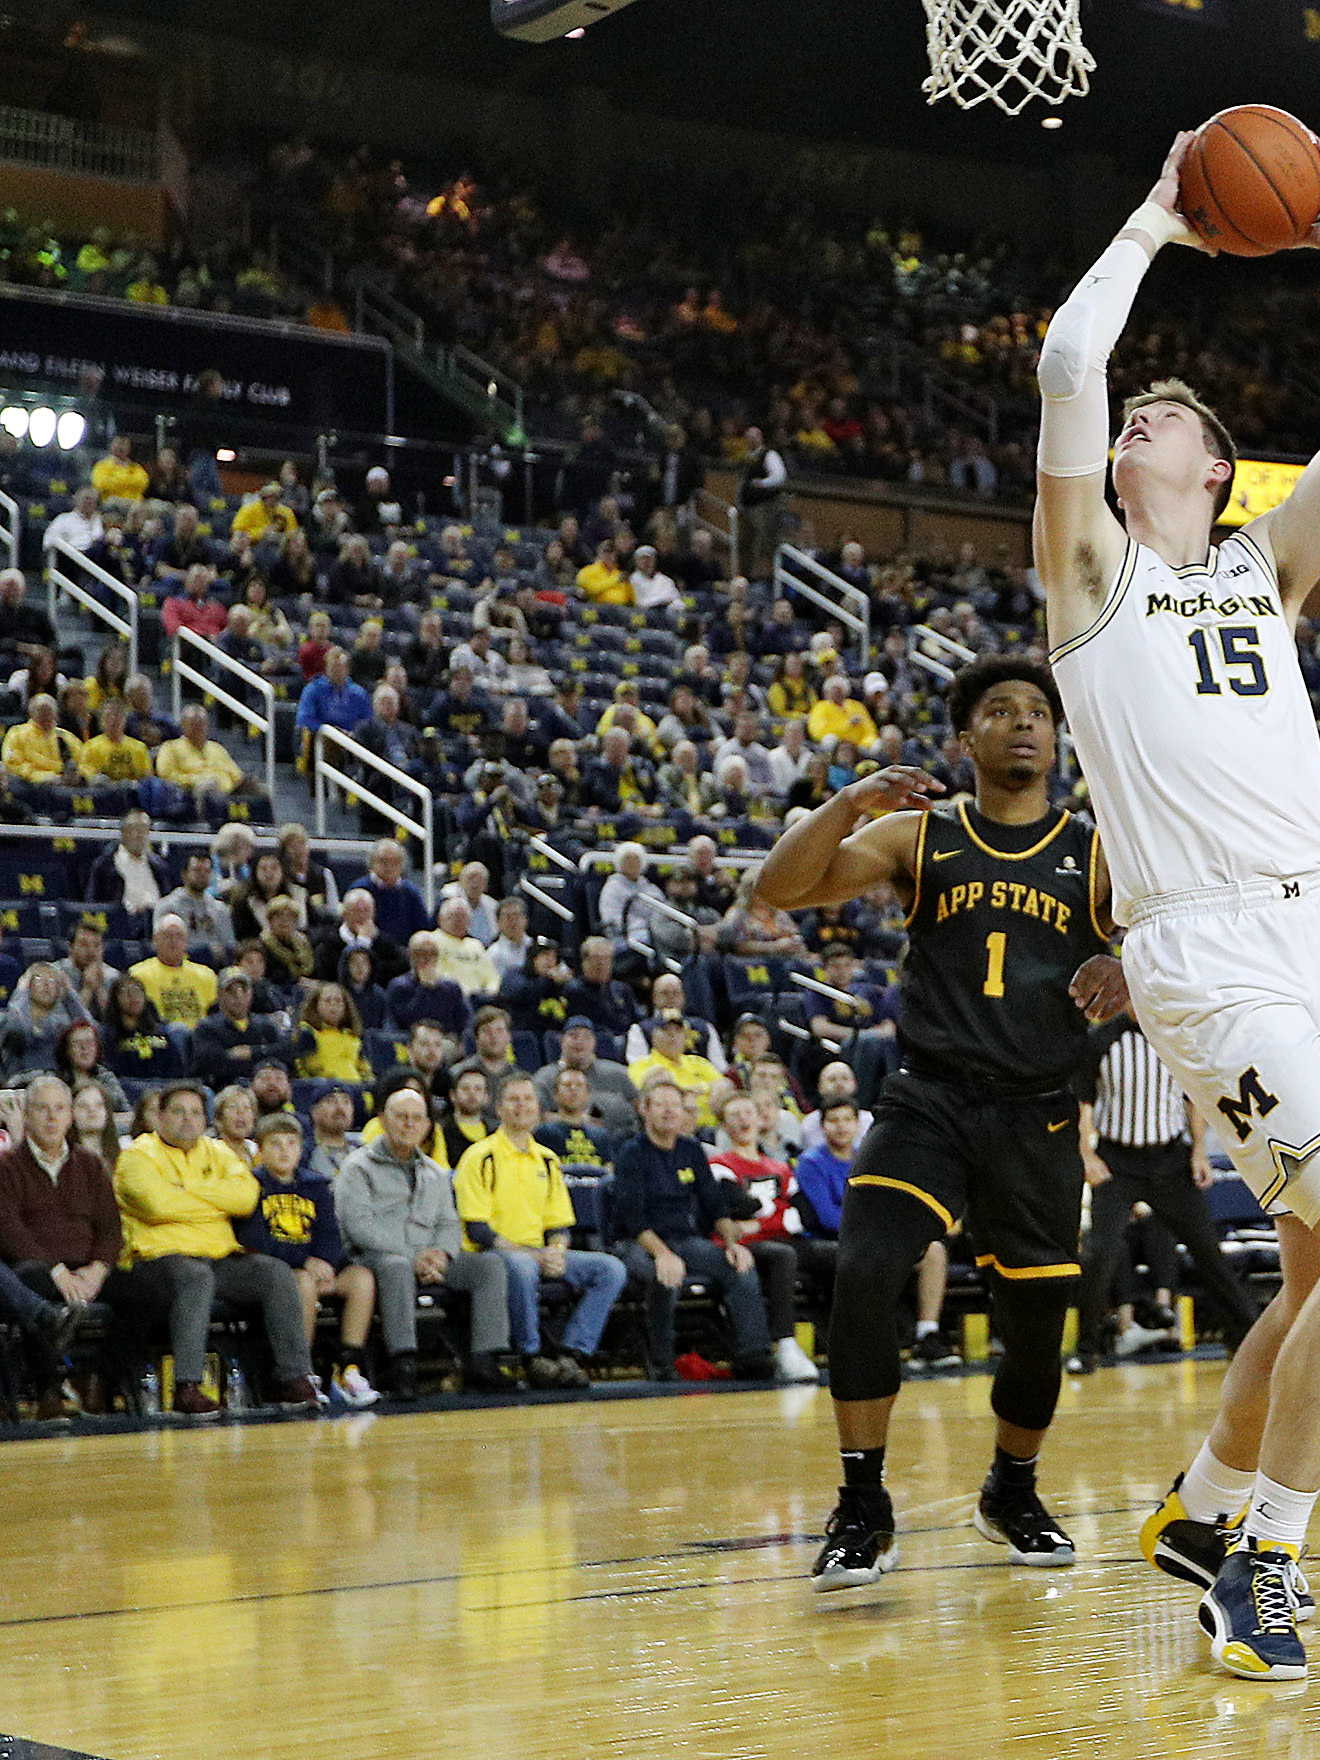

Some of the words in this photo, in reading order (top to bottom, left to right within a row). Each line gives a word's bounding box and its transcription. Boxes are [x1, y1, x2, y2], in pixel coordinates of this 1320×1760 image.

[182, 373, 243, 400] FALY
[1145, 591, 1280, 618] MICHGN
[1188, 625, 1270, 697] 15
[18, 873, 46, 895] M
[1281, 881, 1301, 899] M
[936, 881, 985, 923] APP
[990, 880, 1072, 935] STATE
[747, 966, 770, 985] M
[982, 931, 1008, 998] 1
[1216, 1065, 1281, 1144] M
